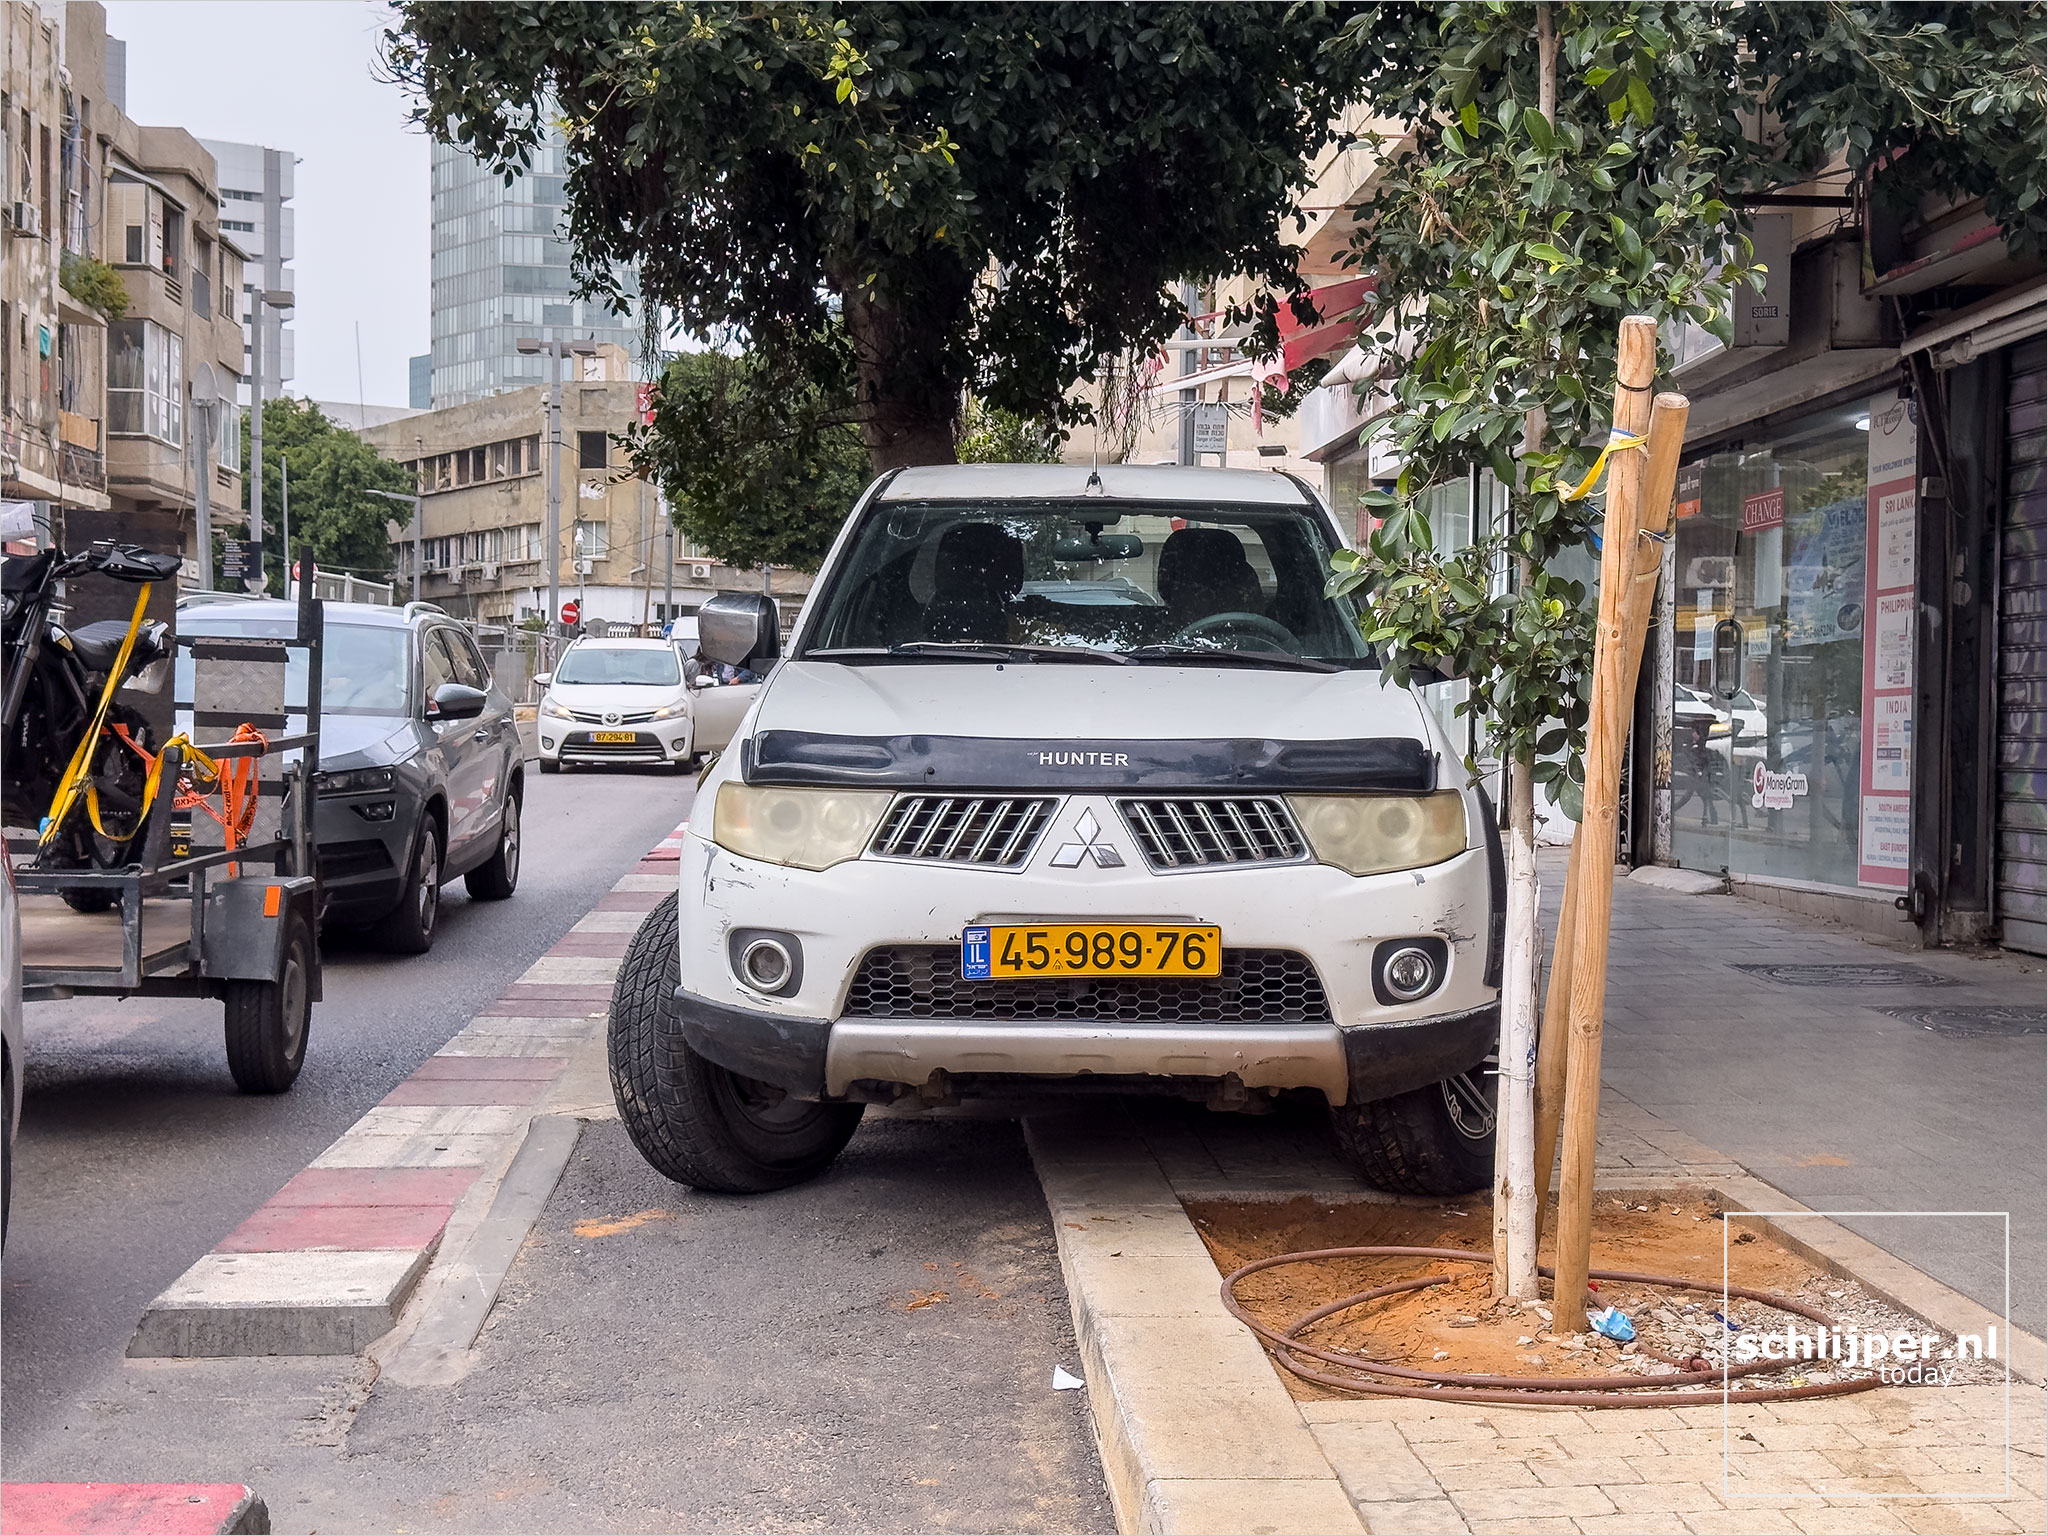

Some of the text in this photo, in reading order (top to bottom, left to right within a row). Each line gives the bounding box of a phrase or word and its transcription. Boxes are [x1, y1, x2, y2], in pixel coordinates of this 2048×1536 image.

[1753, 307, 1777, 318] SORIE
[1745, 498, 1782, 525] CHANGE
[1885, 495, 1916, 514] SRI LANK
[1886, 701, 1908, 714] INDIA
[1040, 752, 1129, 767] HUNTER
[1766, 776, 1805, 794] MoneyGram
[1878, 803, 1892, 812] SOUTH
[1880, 842, 1891, 851] EAST
[970, 944, 985, 963] IL
